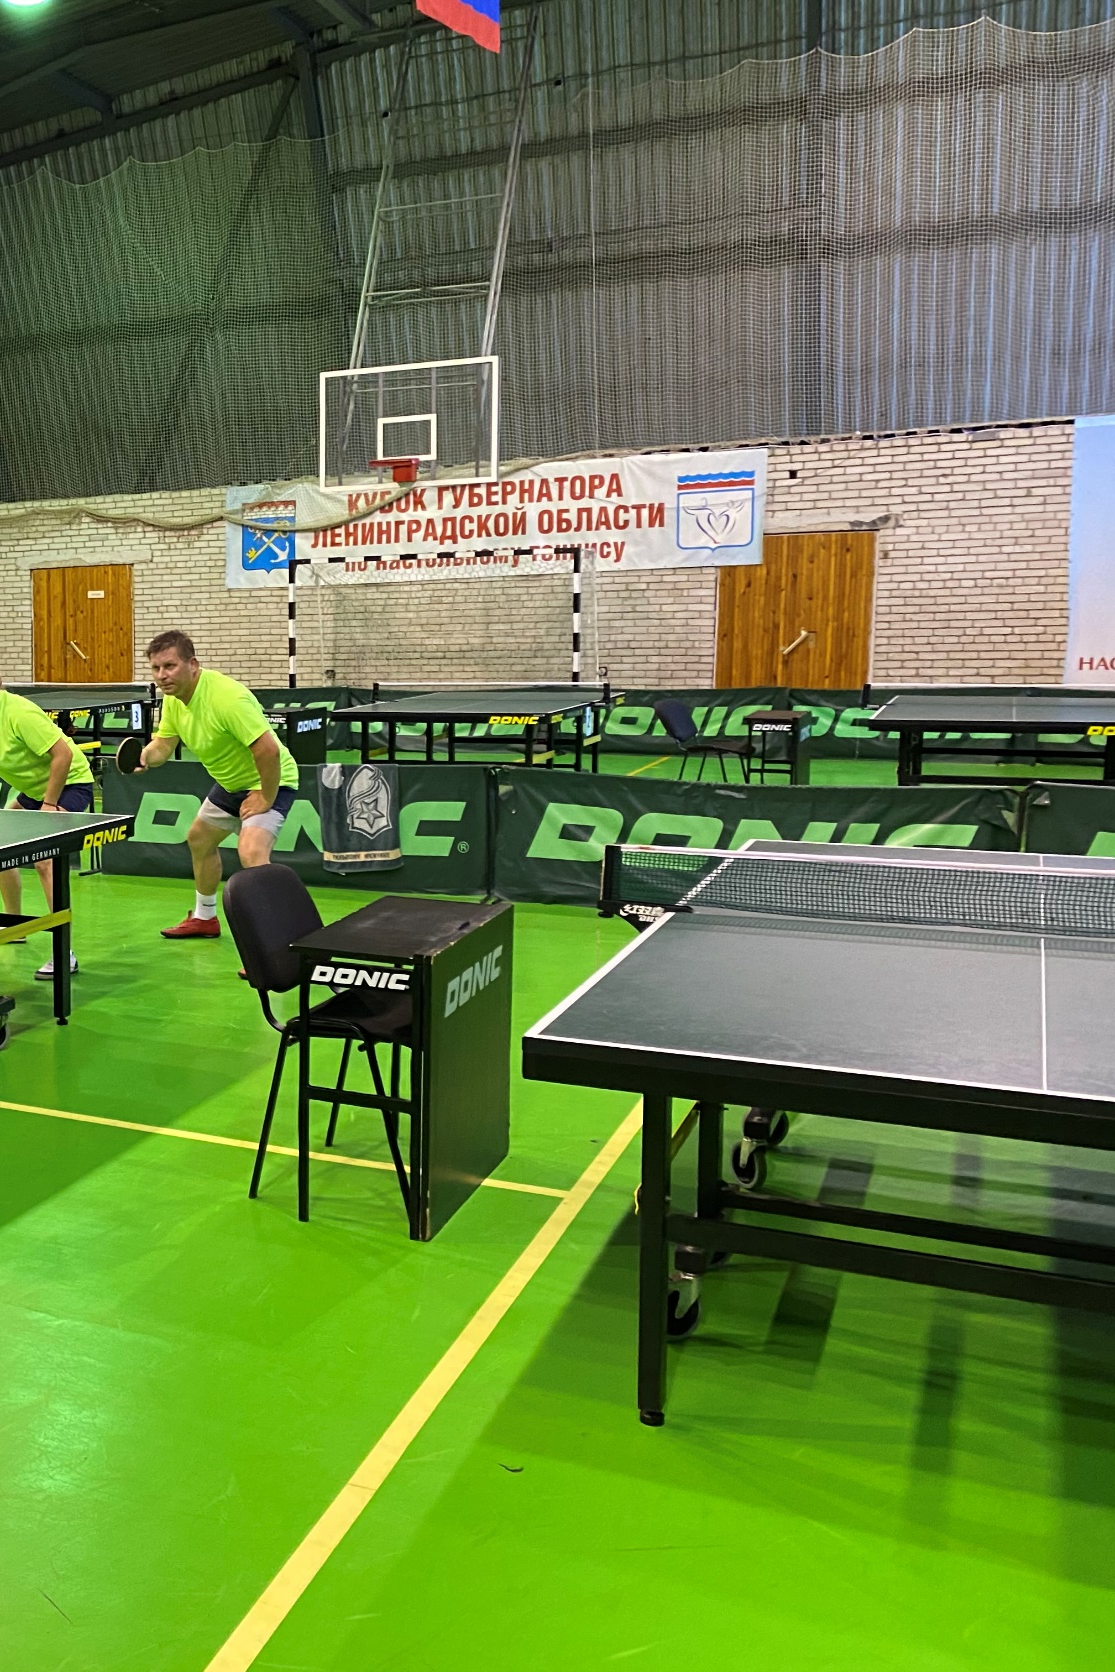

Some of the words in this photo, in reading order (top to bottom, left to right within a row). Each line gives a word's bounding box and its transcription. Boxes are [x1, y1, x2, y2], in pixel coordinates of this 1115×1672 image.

[437, 472, 623, 511] ГУБЕРНАТОРА
[311, 506, 527, 549] ЛЕНИНГРАДСКОЙ
[537, 502, 666, 534] ОБЛАСТИ
[1078, 656, 1115, 671] НАС
[133, 711, 140, 724] 3
[296, 717, 323, 734] DONIC
[488, 715, 540, 725] DONIC
[752, 723, 792, 732] DONIC
[81, 825, 128, 851] DONIC
[0, 857, 20, 869] MADE
[22, 855, 30, 864] IN
[32, 848, 61, 861] GERMANY
[310, 964, 411, 991] DONIC
[444, 945, 504, 1018] DONIC
